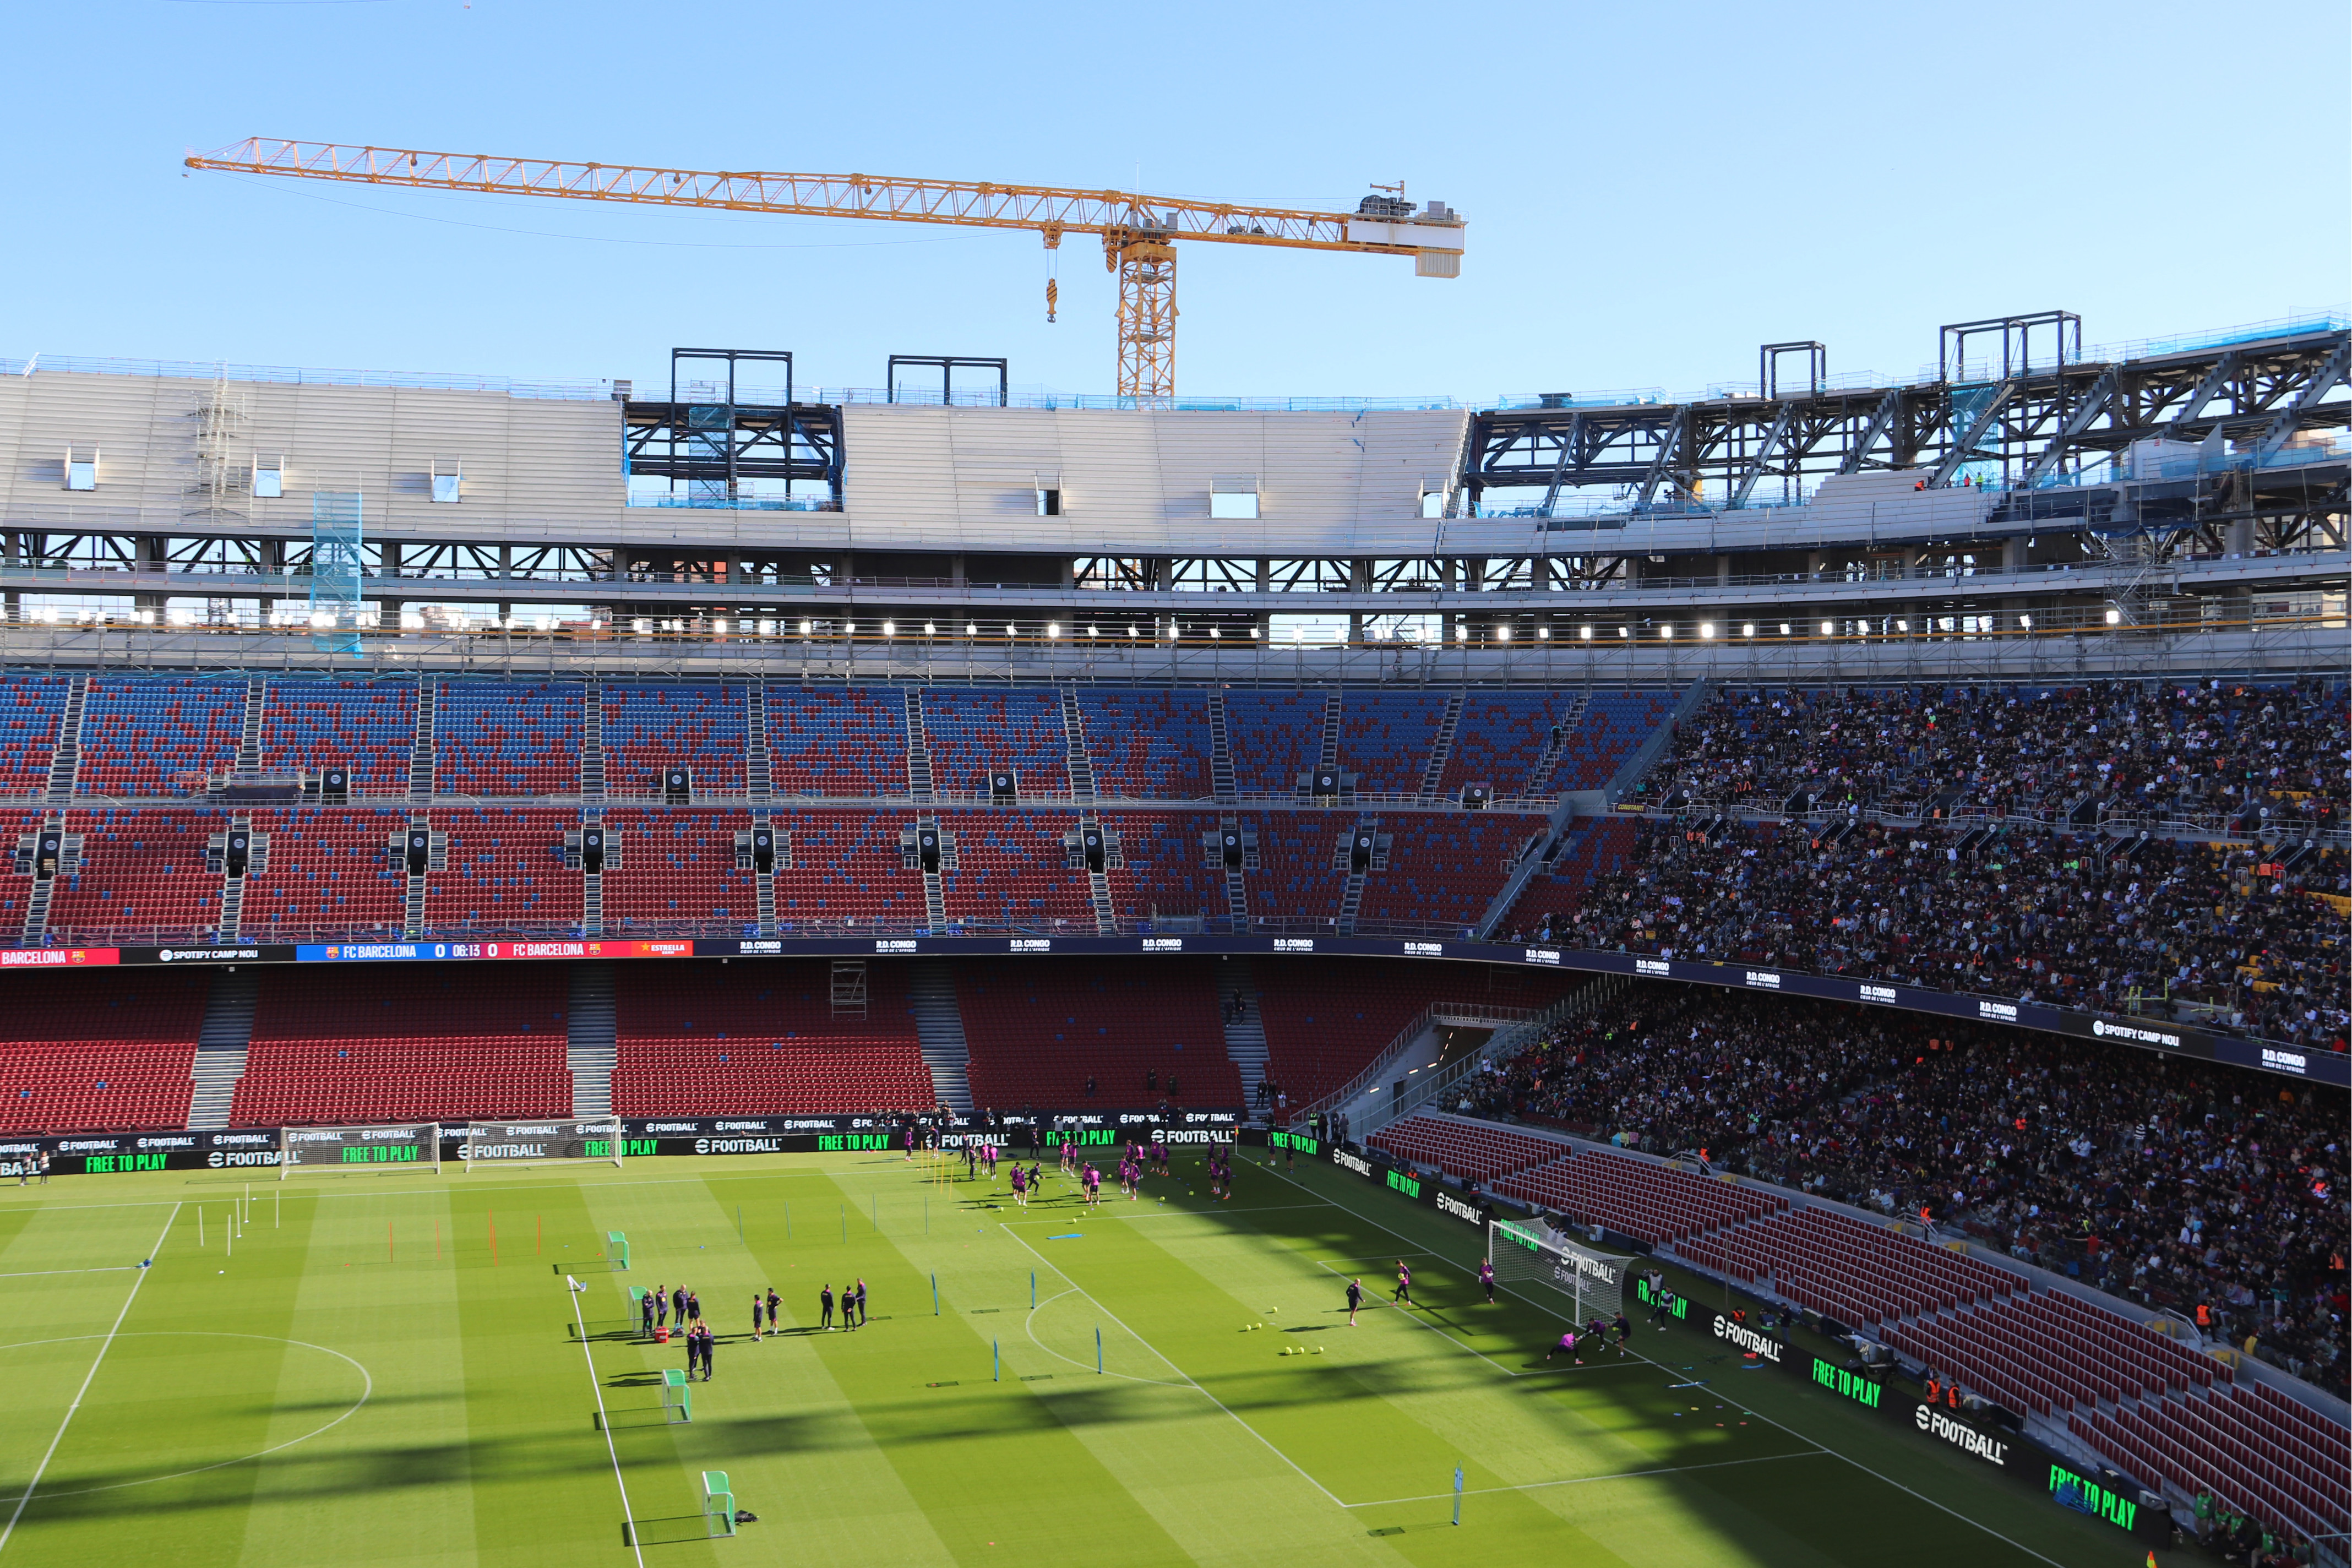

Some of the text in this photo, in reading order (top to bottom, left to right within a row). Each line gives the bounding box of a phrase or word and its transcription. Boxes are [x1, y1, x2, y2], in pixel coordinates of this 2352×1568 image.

[343, 943, 584, 959] FC BARCELONA 0 06:13 0 FC BARCELONA
[740, 941, 781, 949] R.D. CONGO
[1287, 939, 1314, 948] CONGO
[1404, 942, 1442, 952] R.D. CONGO
[2, 951, 66, 965] BARCELONA
[173, 950, 258, 960] SPOTIFY CAMP NOU
[1526, 949, 1560, 959] R.D. CONGO
[1636, 960, 1669, 971] R.D. CONGO
[1746, 971, 1780, 983] R.D. CONGO
[1860, 986, 1896, 998] R.D. CONGO
[1979, 1001, 2017, 1016] R.D. CONGO
[2104, 1024, 2180, 1047] SPOTIFY CAMP NOU
[2262, 1048, 2306, 1068] R.D. CONGO
[819, 1134, 889, 1151] FREE TO PLAY
[1090, 1130, 1115, 1145] PLAY
[1302, 1136, 1317, 1155] PLAY
[342, 1145, 418, 1163] FREE TO PLAY
[585, 1141, 611, 1156] FREE
[630, 1139, 657, 1155] PLAY
[86, 1153, 167, 1173] FREE TO PLAY
[1387, 1170, 1420, 1199] FREE TO PLAY
[1500, 1218, 1515, 1241] FREE
[1516, 1224, 1523, 1245] TO
[1812, 1358, 1881, 1408] FREE TO PLAY
[2083, 1479, 2100, 1513] TO
[2101, 1489, 2136, 1531] PLAY
